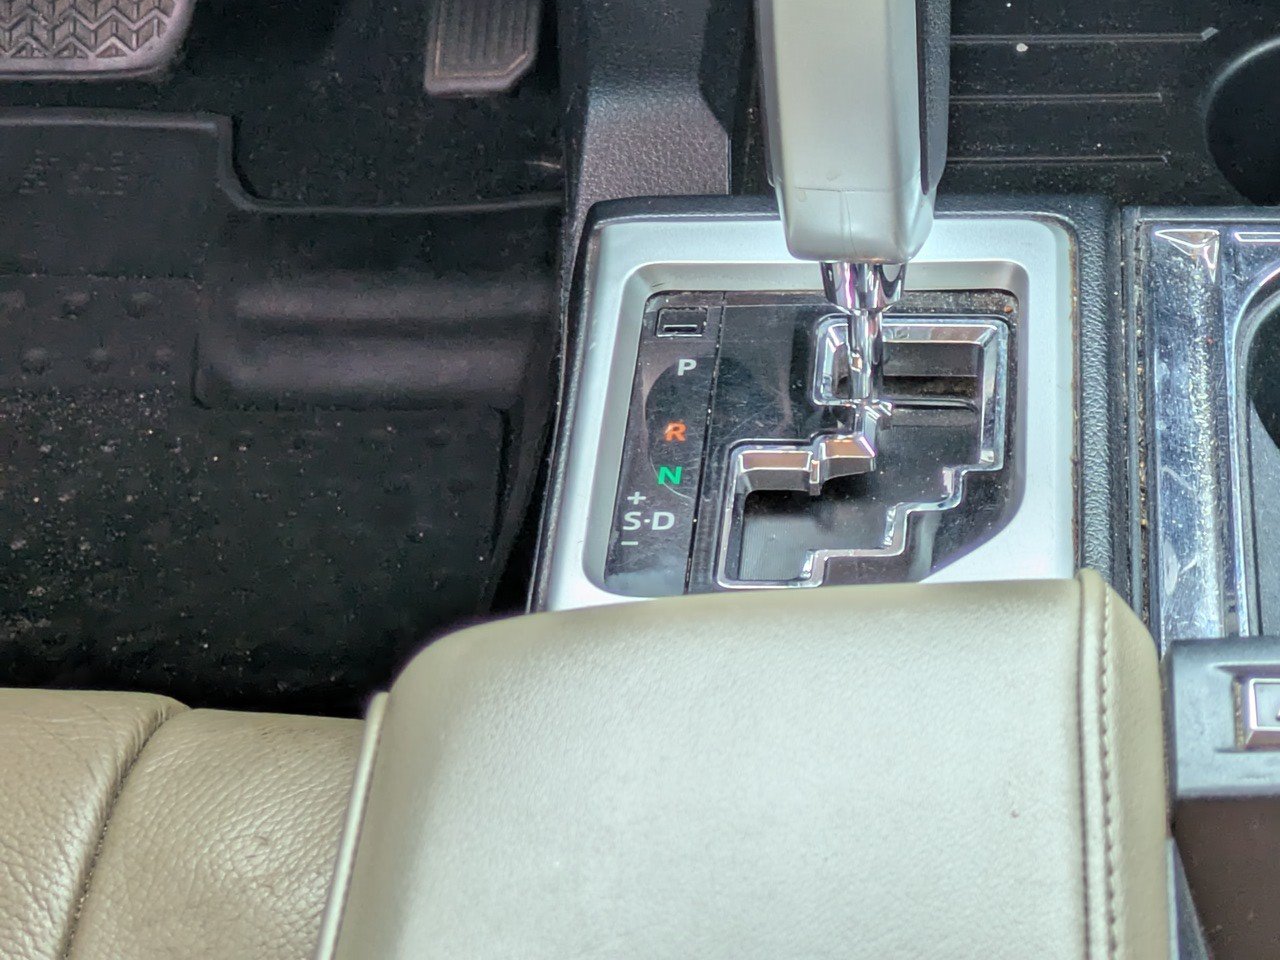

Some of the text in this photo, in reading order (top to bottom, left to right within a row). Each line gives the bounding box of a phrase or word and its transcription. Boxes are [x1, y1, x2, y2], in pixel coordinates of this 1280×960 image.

[677, 359, 698, 376] P
[664, 421, 688, 442] R
[657, 466, 683, 485] N
